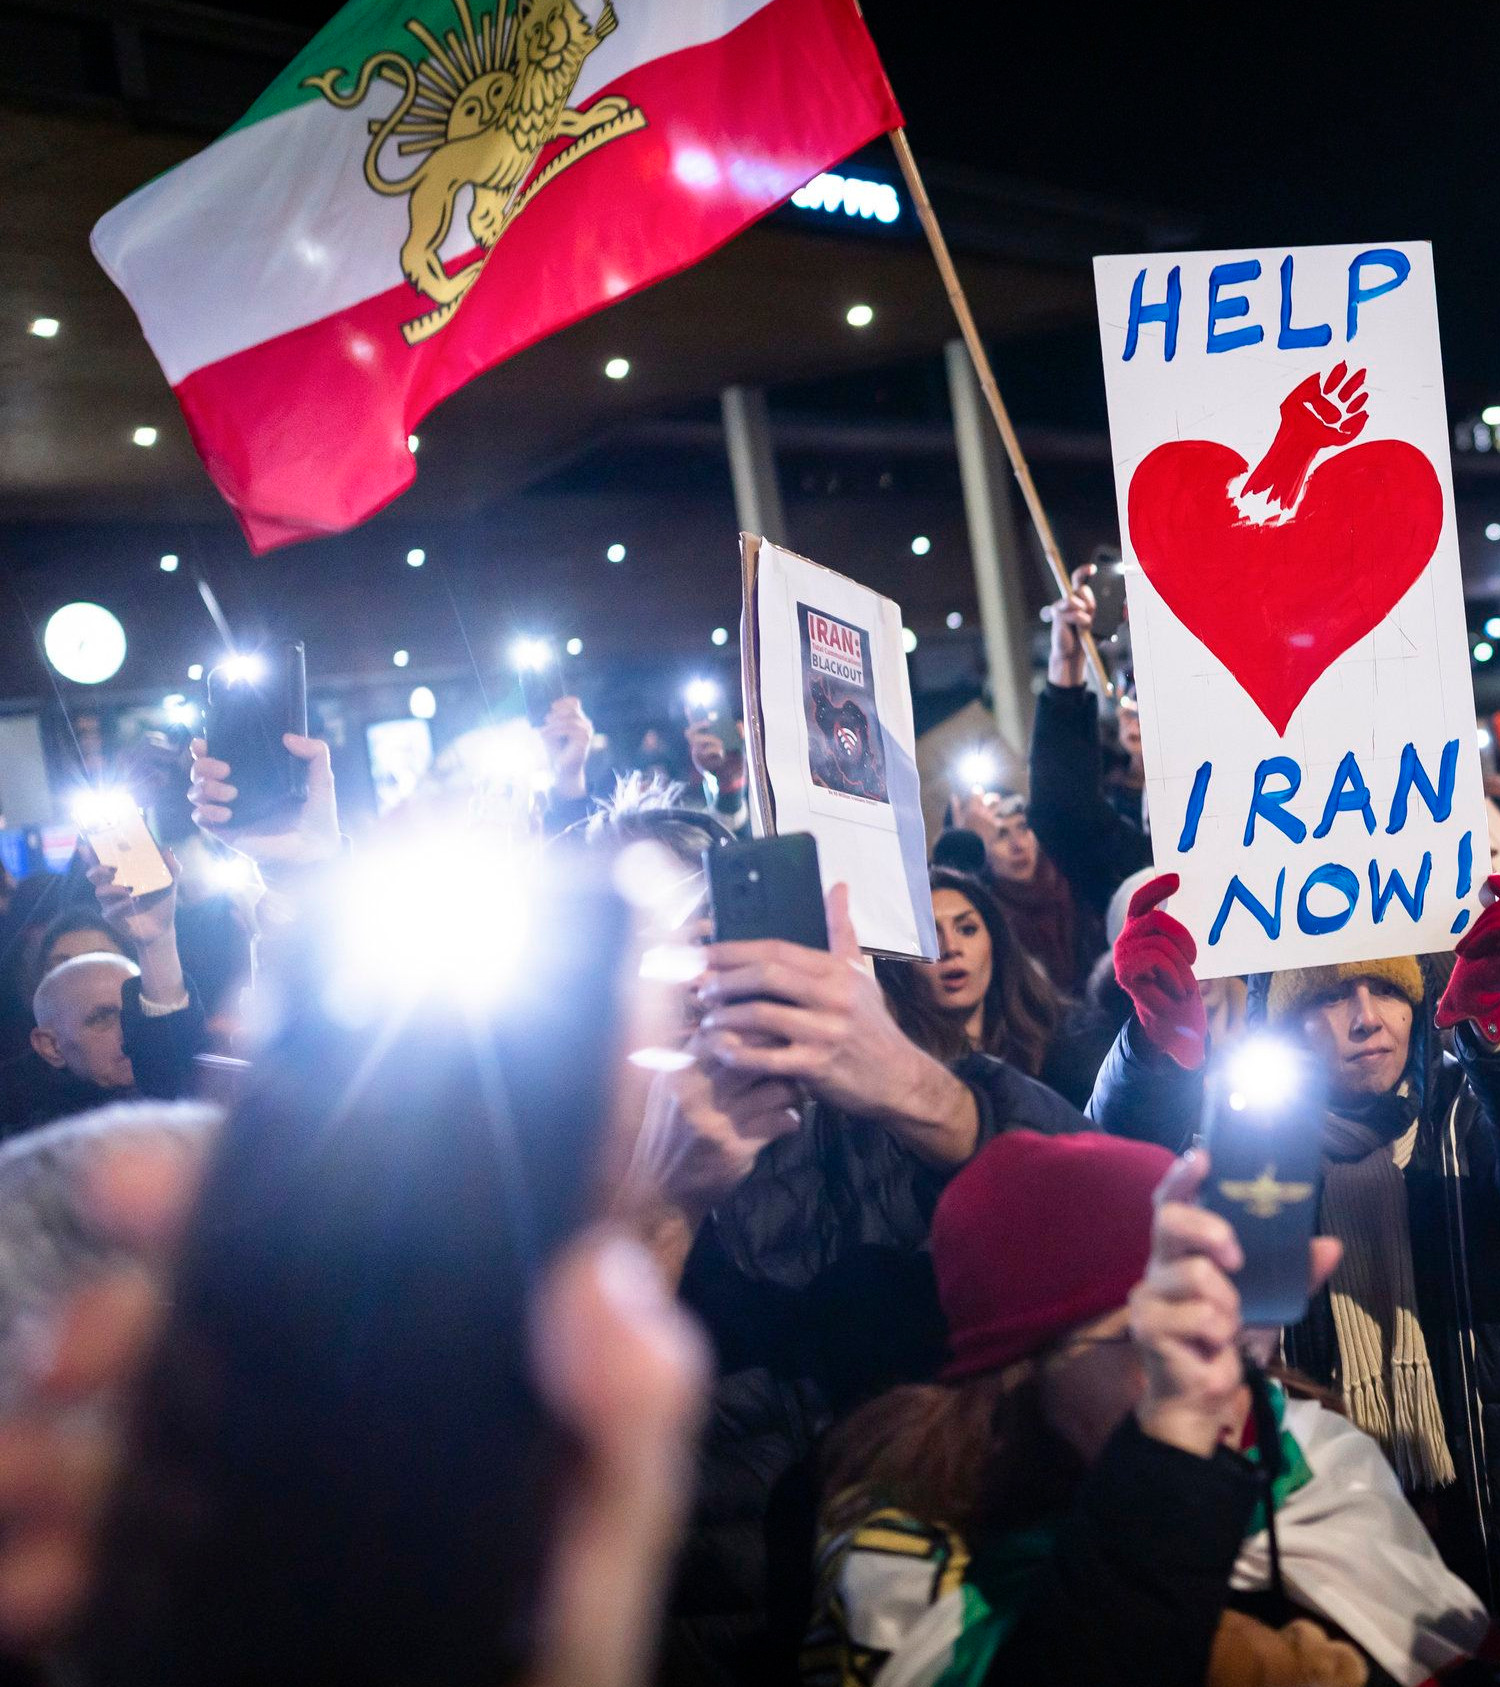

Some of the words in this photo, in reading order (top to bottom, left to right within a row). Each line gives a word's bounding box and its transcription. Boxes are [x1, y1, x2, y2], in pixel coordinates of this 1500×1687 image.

[1122, 249, 1411, 362] HELP
[809, 614, 861, 658] IRAN:
[812, 653, 862, 684] BLACKOUT
[1179, 739, 1459, 852] IRAN
[1208, 831, 1472, 946] NOW!
